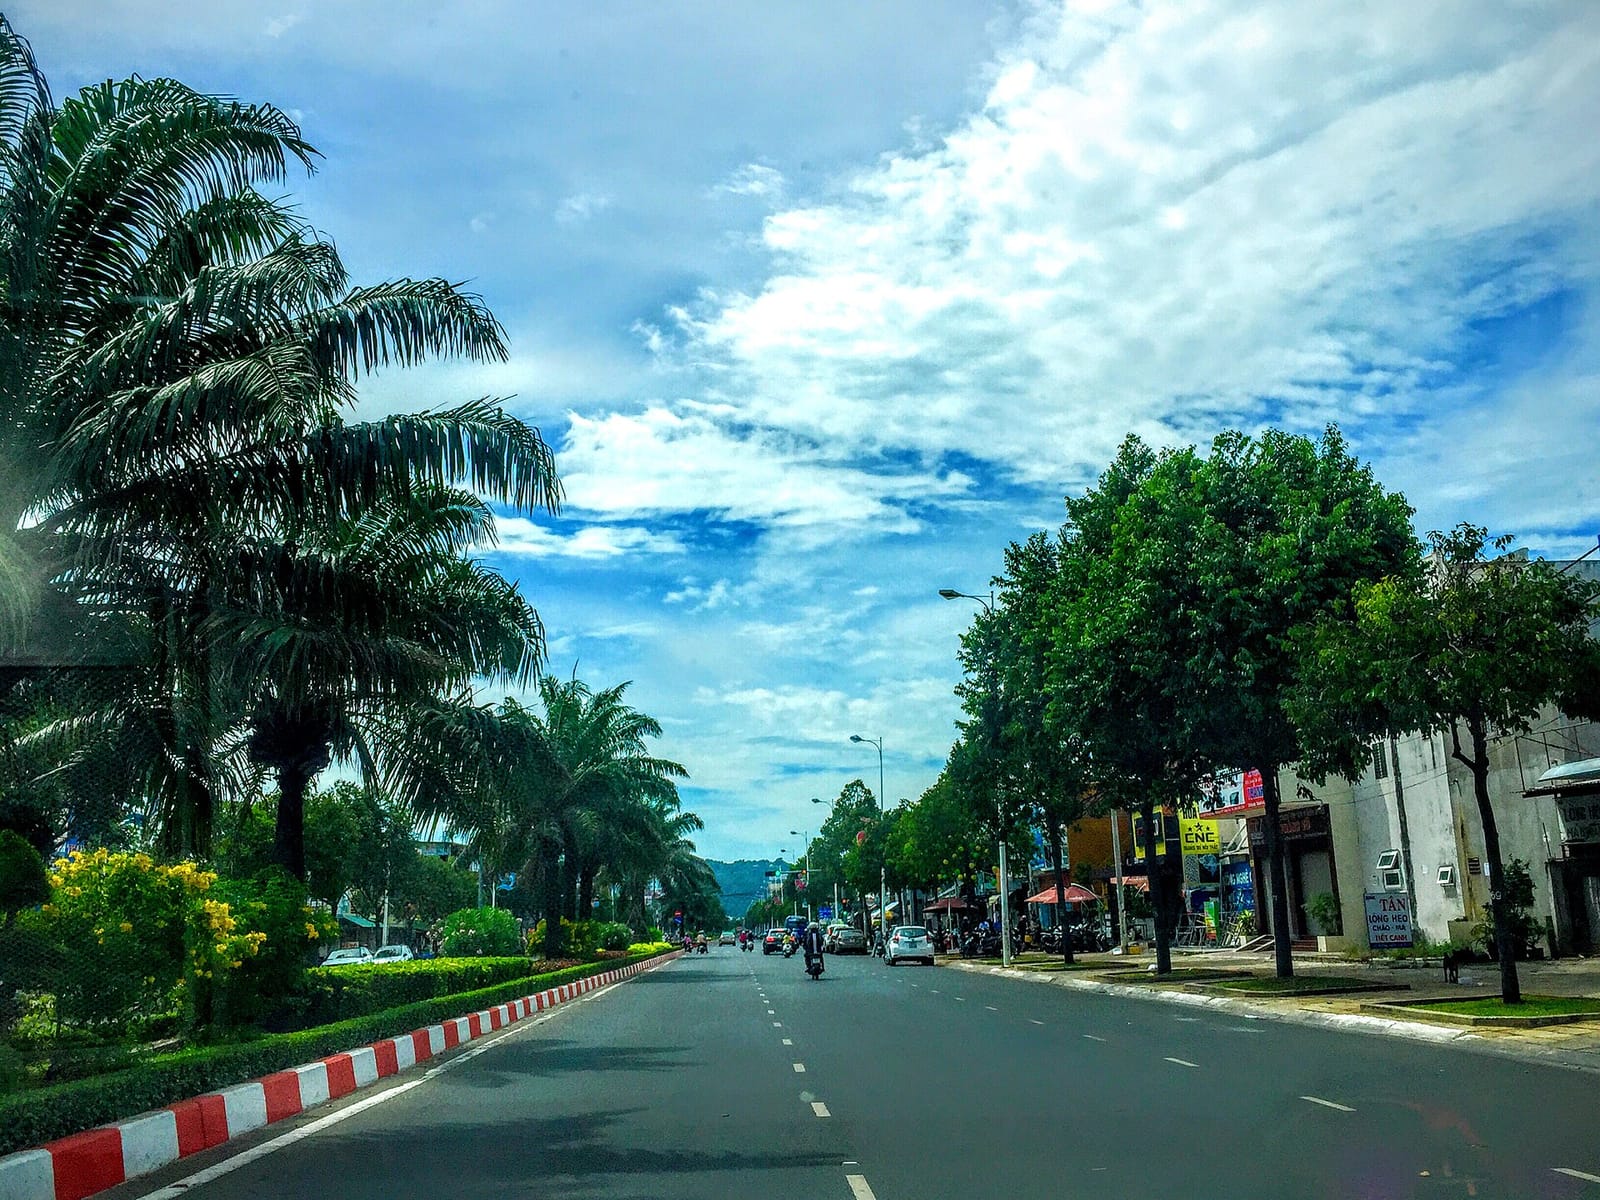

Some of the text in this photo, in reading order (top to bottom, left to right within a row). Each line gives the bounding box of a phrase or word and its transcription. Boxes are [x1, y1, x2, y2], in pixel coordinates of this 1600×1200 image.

[1185, 832, 1214, 843] CNC
[1379, 895, 1406, 912] TÂN
[1392, 914, 1408, 923] HEO
